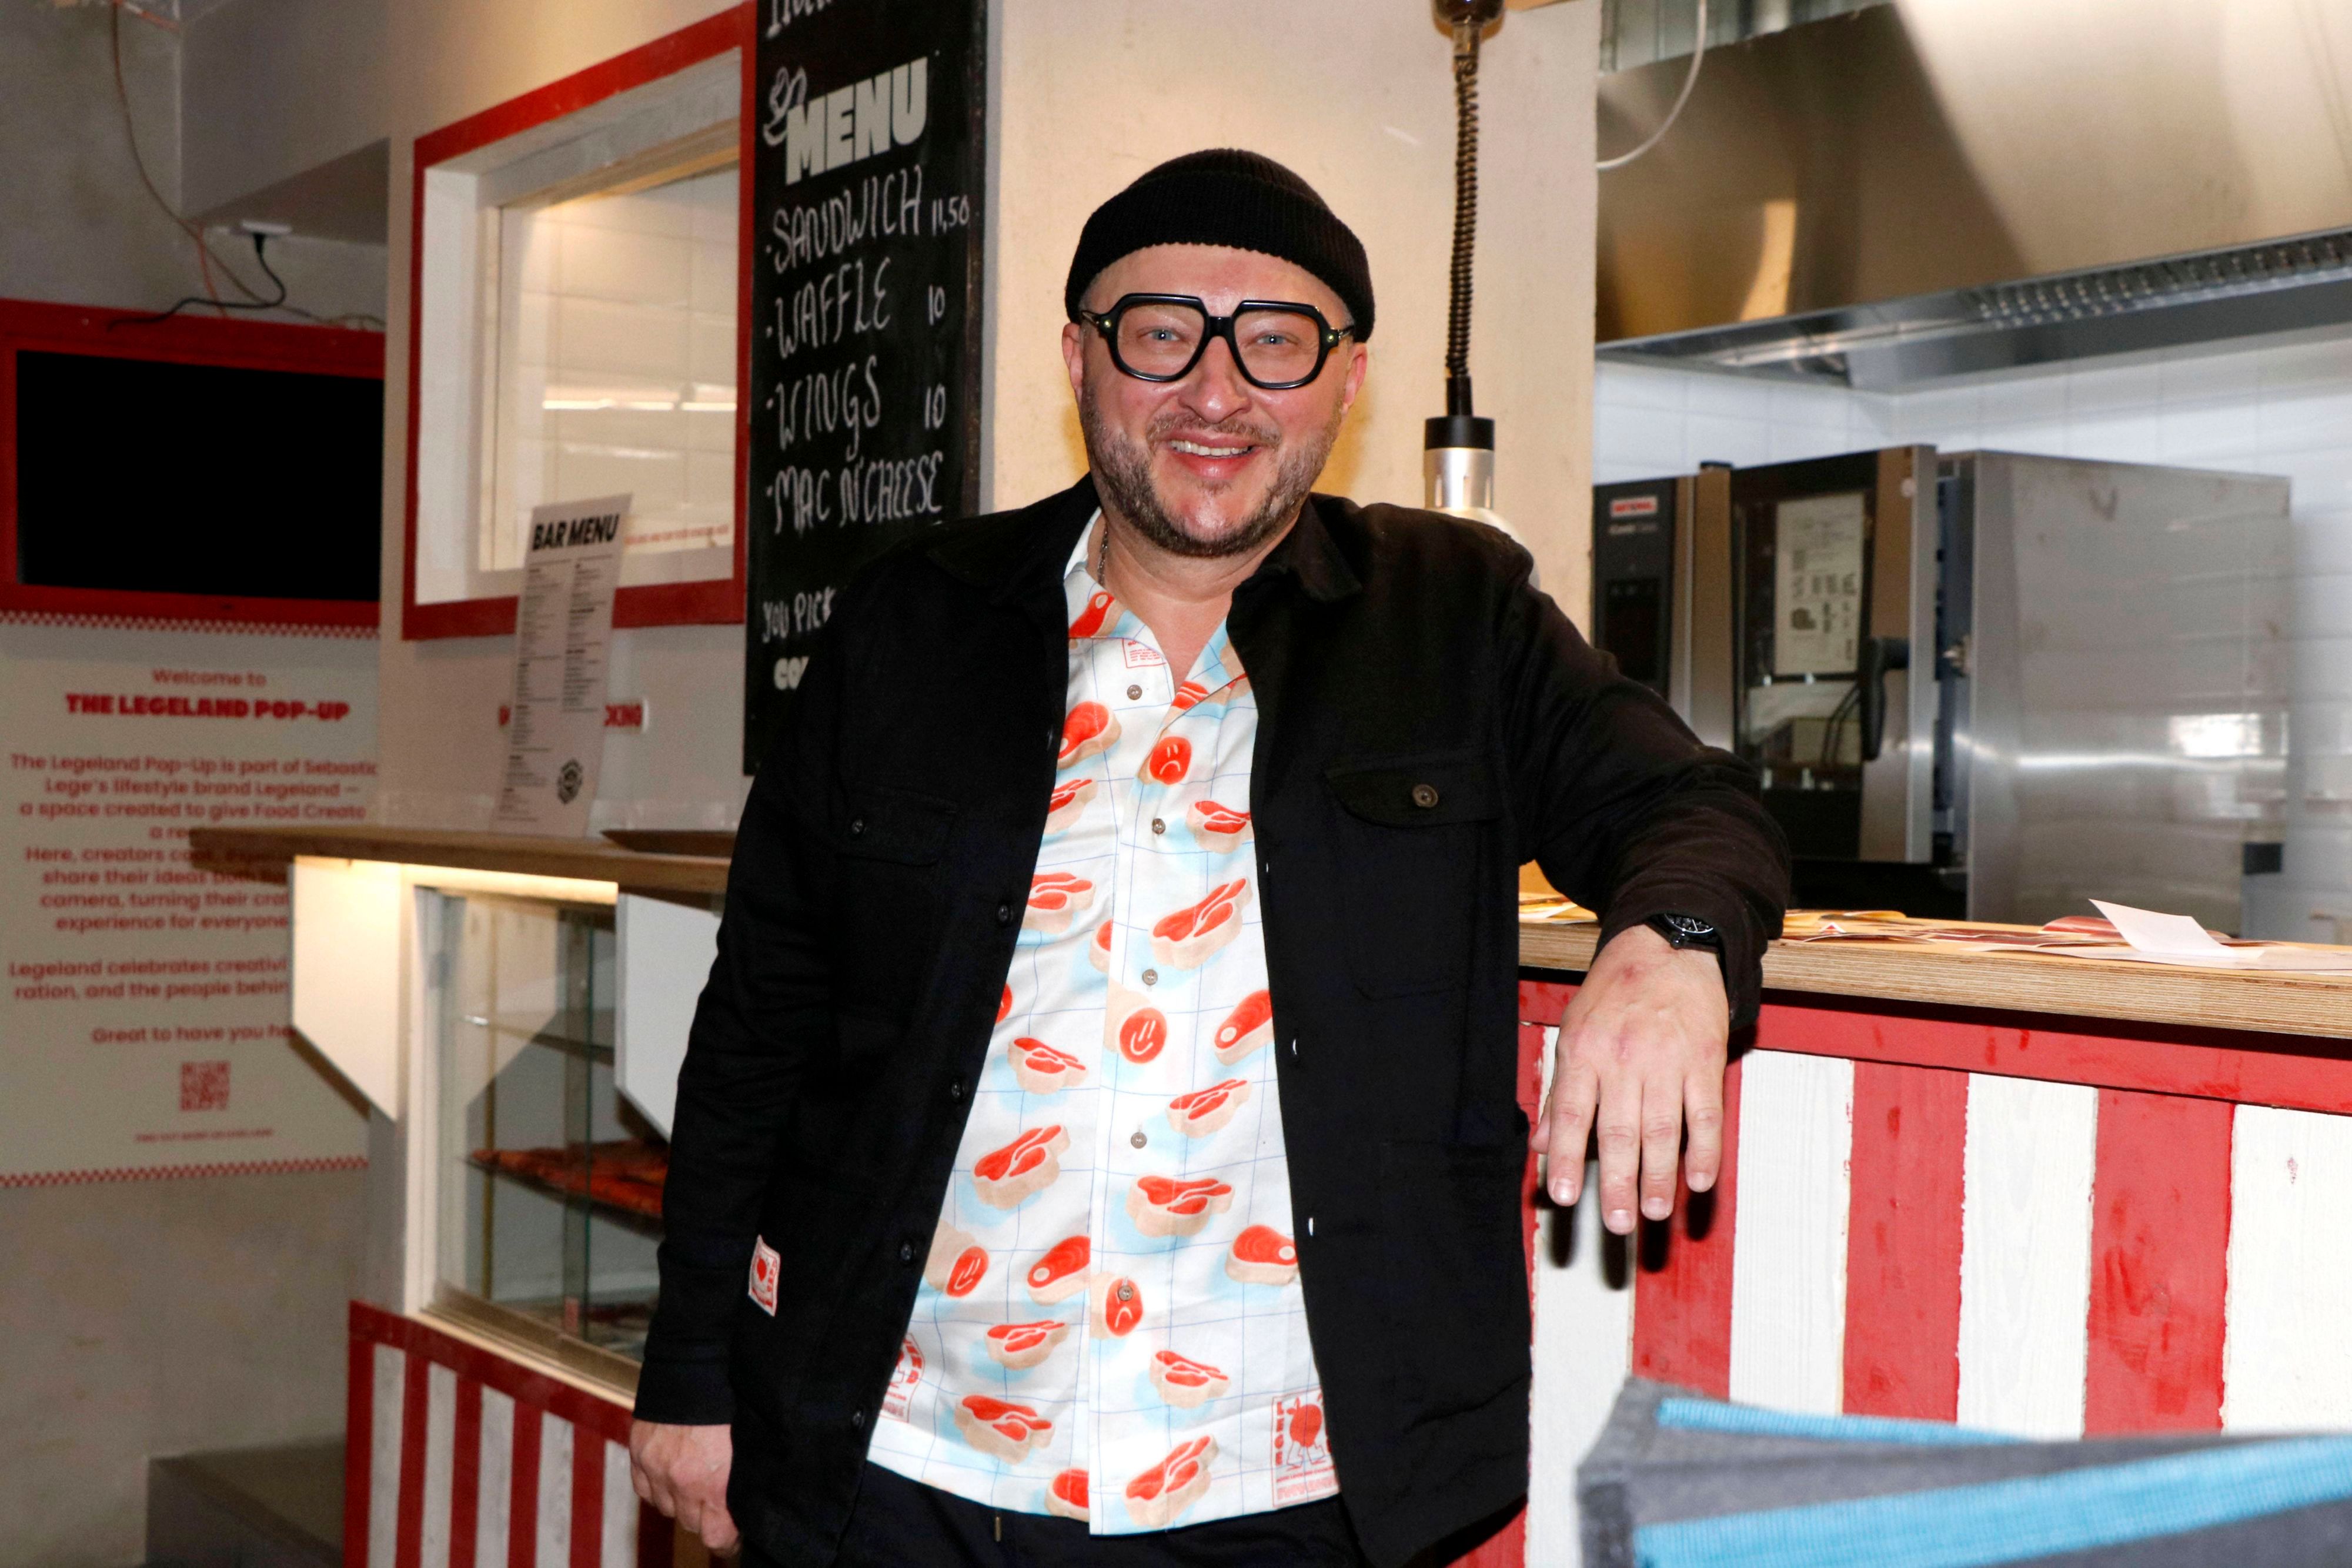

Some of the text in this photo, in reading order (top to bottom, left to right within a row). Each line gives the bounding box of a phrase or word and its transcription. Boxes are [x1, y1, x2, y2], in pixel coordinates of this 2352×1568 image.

[786, 57, 927, 185] MENU
[773, 165, 922, 273] SANDWICH
[775, 257, 946, 359] WAFFLE 10
[776, 355, 946, 462] WINGS 10
[774, 466, 831, 534] MAC
[532, 520, 567, 551] BAR
[567, 513, 620, 546] MENU
[763, 601, 790, 643] YOU
[152, 668, 266, 687] Welcome to
[66, 693, 350, 720] THE LEGELAND POP-UP
[12, 753, 46, 768] The
[51, 755, 140, 775] Legeland
[145, 757, 215, 776] Pop-Up
[221, 758, 235, 771] is
[240, 760, 278, 776] part
[282, 761, 300, 774] of
[46, 778, 108, 799] Lege's
[113, 779, 188, 798] lifestyle
[194, 781, 252, 796] brand
[256, 783, 340, 800] Legeland
[19, 803, 33, 817] a
[39, 803, 100, 820] space
[105, 803, 181, 817] created
[186, 804, 205, 818] to
[209, 805, 250, 821] give
[254, 805, 299, 819] Food
[81, 848, 165, 862] creators
[43, 870, 100, 885] share
[106, 870, 148, 884] their
[155, 870, 207, 884] ideas
[129, 892, 201, 911] turning
[205, 892, 247, 907] their
[56, 917, 166, 934] experience
[169, 914, 195, 930] for
[9, 959, 102, 981] Legeland
[107, 959, 211, 975] celebrates
[85, 983, 125, 998] and
[129, 982, 161, 996] the
[166, 982, 232, 1000] people
[92, 1027, 147, 1043] Great
[152, 1027, 172, 1042] to
[176, 1027, 225, 1042] have
[229, 1027, 265, 1044] you
